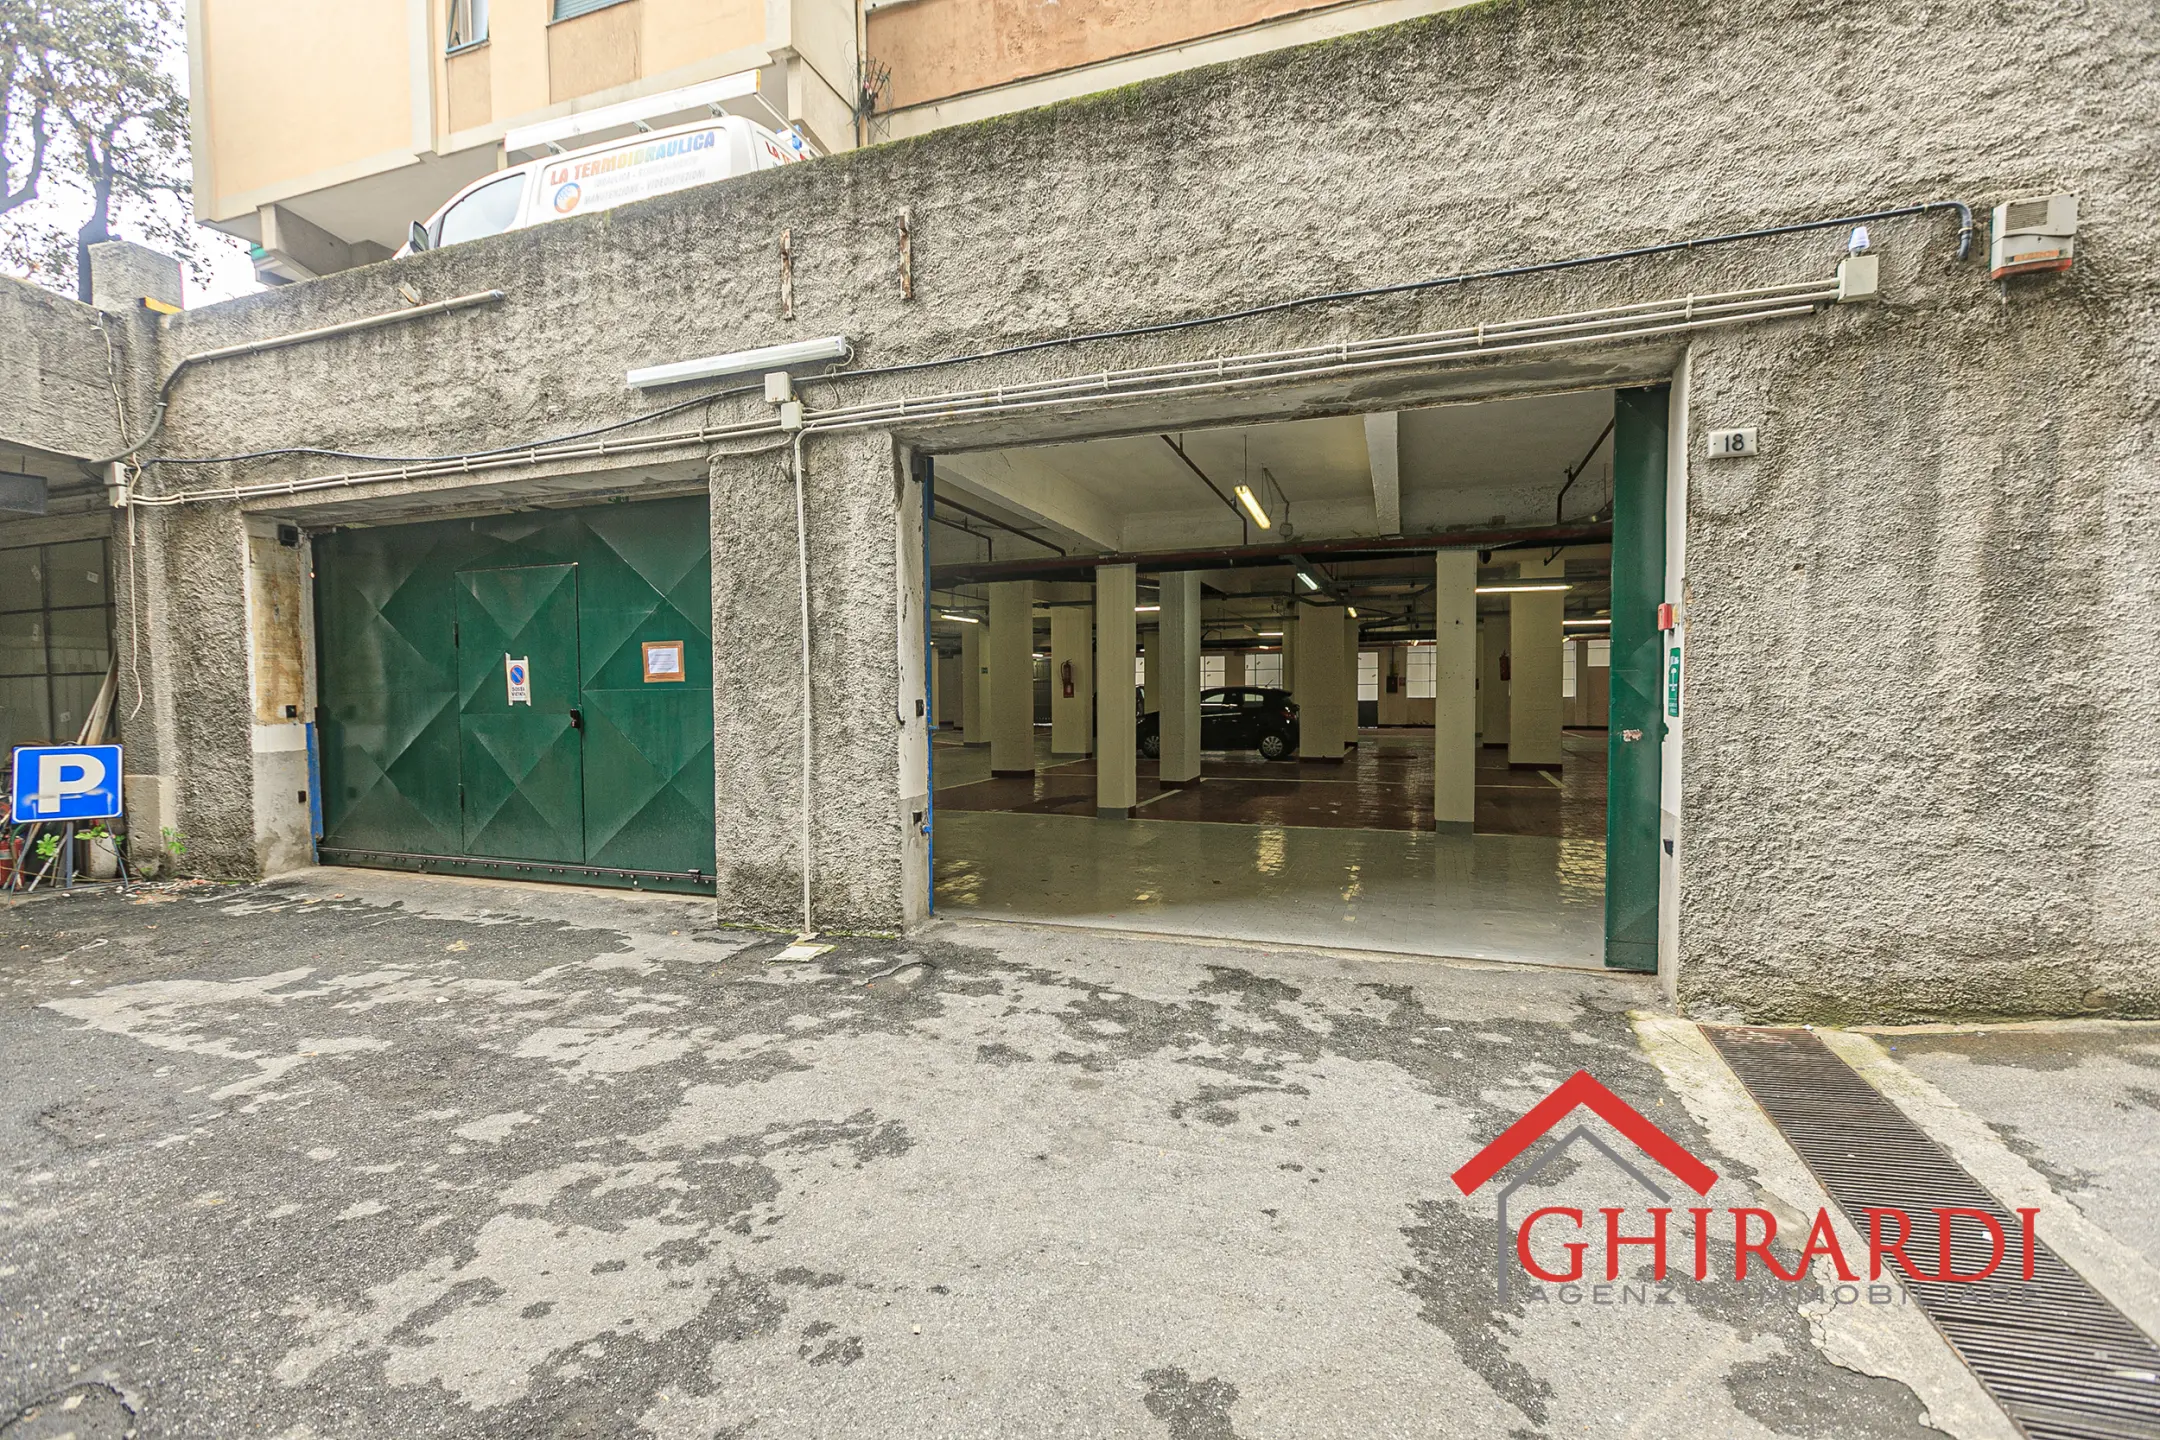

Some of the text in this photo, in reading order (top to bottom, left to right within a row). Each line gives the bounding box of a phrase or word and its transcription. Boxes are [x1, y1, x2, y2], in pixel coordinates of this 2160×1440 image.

[550, 130, 716, 186] LA TERMOIDRAULICA
[1724, 433, 1745, 453] 18
[38, 754, 106, 813] P
